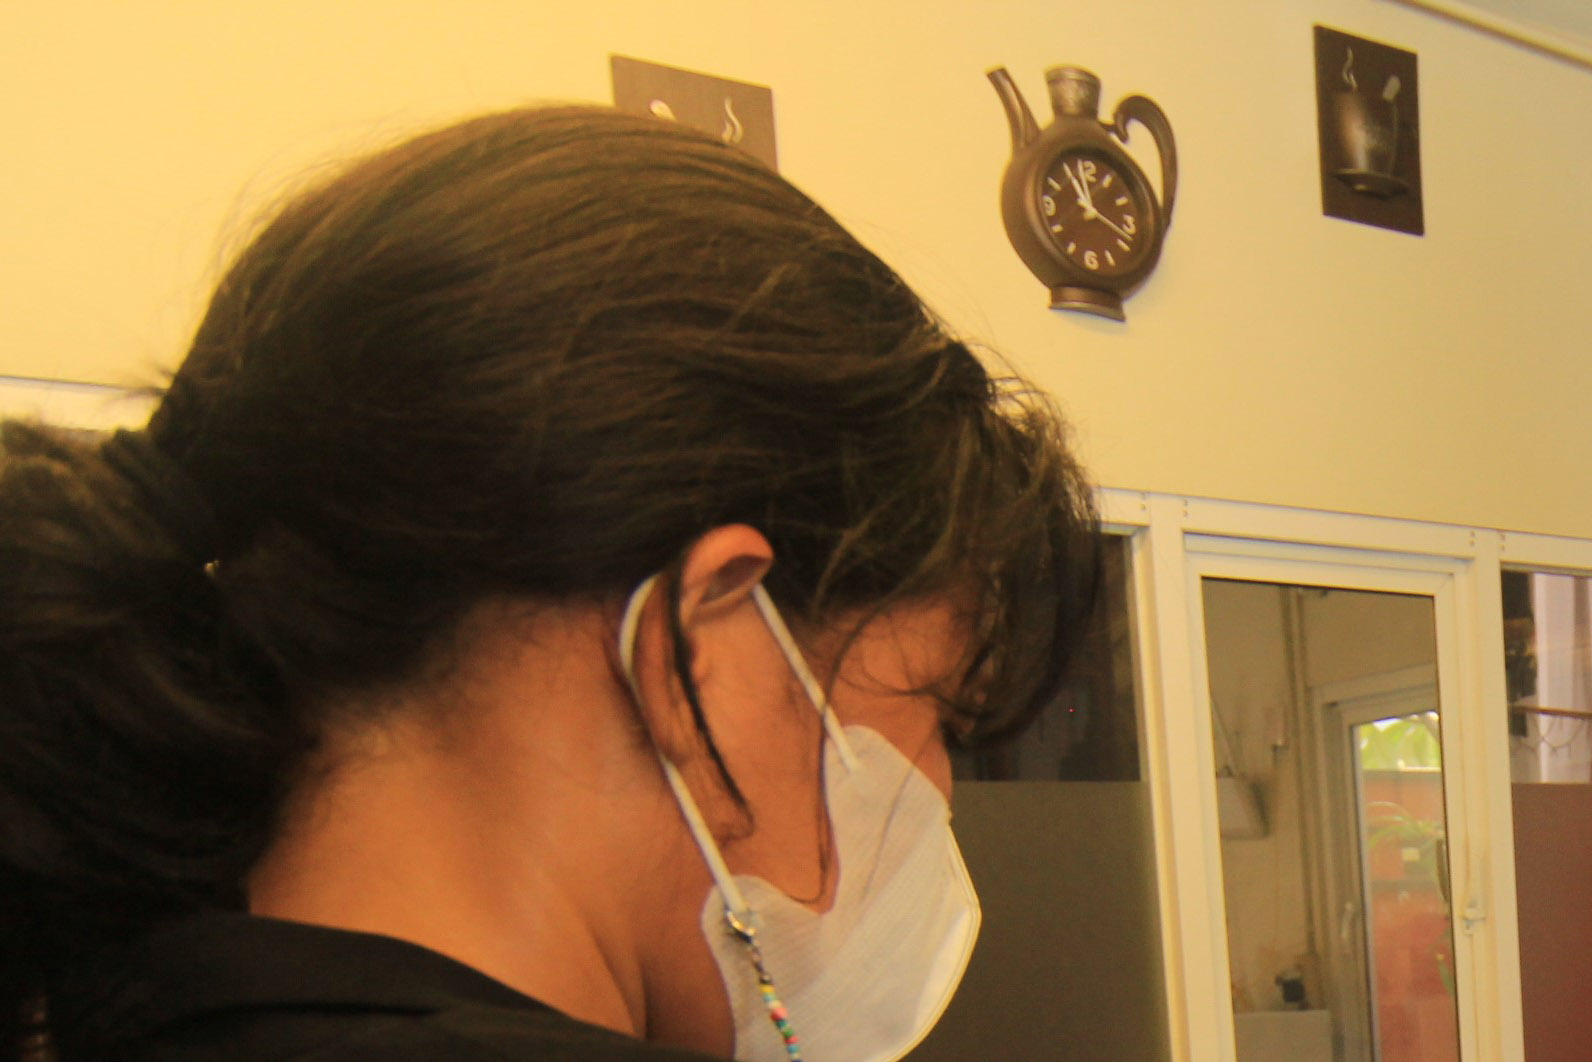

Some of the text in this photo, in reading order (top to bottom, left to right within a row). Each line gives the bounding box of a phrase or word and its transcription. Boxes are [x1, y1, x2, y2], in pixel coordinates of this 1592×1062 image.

[1042, 195, 1056, 216] 9
[1122, 215, 1136, 234] 3
[1084, 250, 1099, 270] 6
